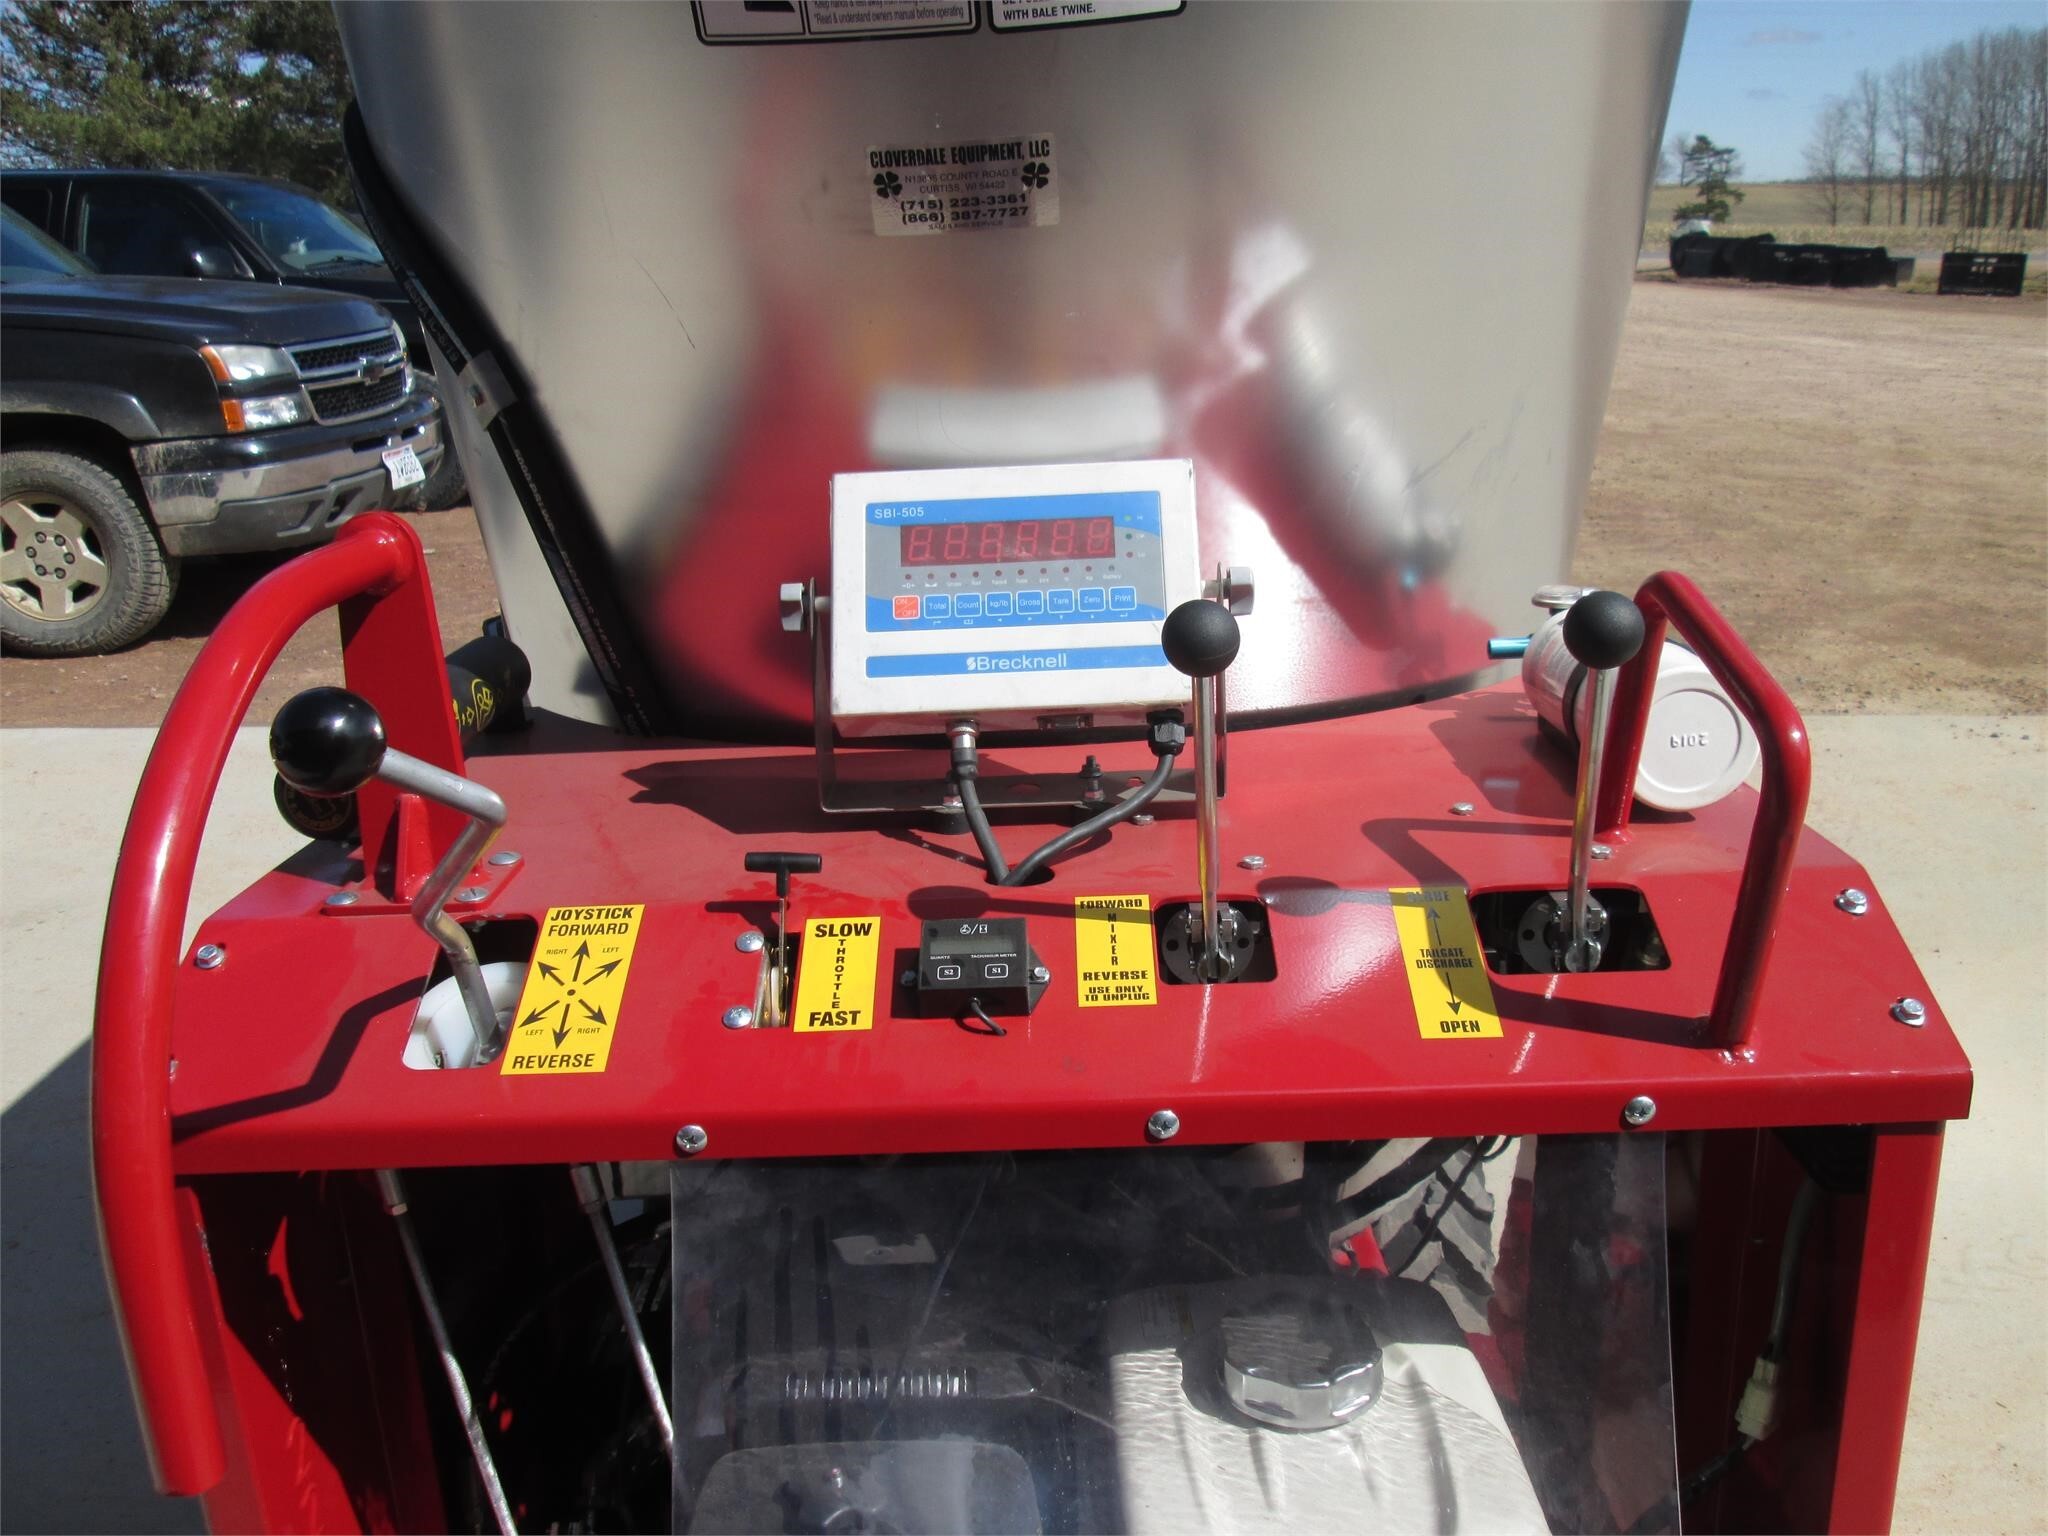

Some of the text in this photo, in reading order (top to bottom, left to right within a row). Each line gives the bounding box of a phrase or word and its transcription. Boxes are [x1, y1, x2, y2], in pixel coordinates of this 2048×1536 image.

[894, 9, 916, 20] manual
[917, 7, 935, 19] before
[936, 5, 964, 18] operating
[1003, 3, 1096, 21] WITH BALE TWINE.
[869, 139, 1050, 168] CLOVERDALE EQUIPMENT, LLC
[940, 171, 979, 181] COUNTY
[982, 169, 1009, 178] ROAD
[965, 182, 977, 192] WI
[901, 199, 943, 212] (715)
[951, 206, 1028, 221] 387-7727
[874, 506, 924, 520] SBI-505
[1019, 599, 1040, 607] Gross
[1053, 597, 1069, 605] Tare
[1084, 596, 1100, 604] Zero
[1115, 594, 1131, 602] Print
[929, 602, 946, 610] Total
[958, 601, 979, 609] Count
[977, 652, 1067, 671] Brecknell
[1079, 899, 1143, 909] FORWARD
[550, 907, 634, 921] JOYSTICK
[548, 922, 629, 937] FORWARD
[815, 923, 872, 938] SLOW
[1107, 913, 1118, 966] MIXER
[1419, 948, 1465, 958] TAILGATE
[1416, 958, 1474, 969] DISCHARGE
[832, 939, 846, 1009] THROTTLE
[1083, 970, 1148, 981] REVERSE
[1089, 985, 1144, 994] USE ONLY
[1085, 992, 1150, 1002] TO UNPLUG
[808, 1010, 861, 1027] FAST
[1440, 1020, 1481, 1033] OPEN
[512, 1053, 595, 1069] REVERSE
